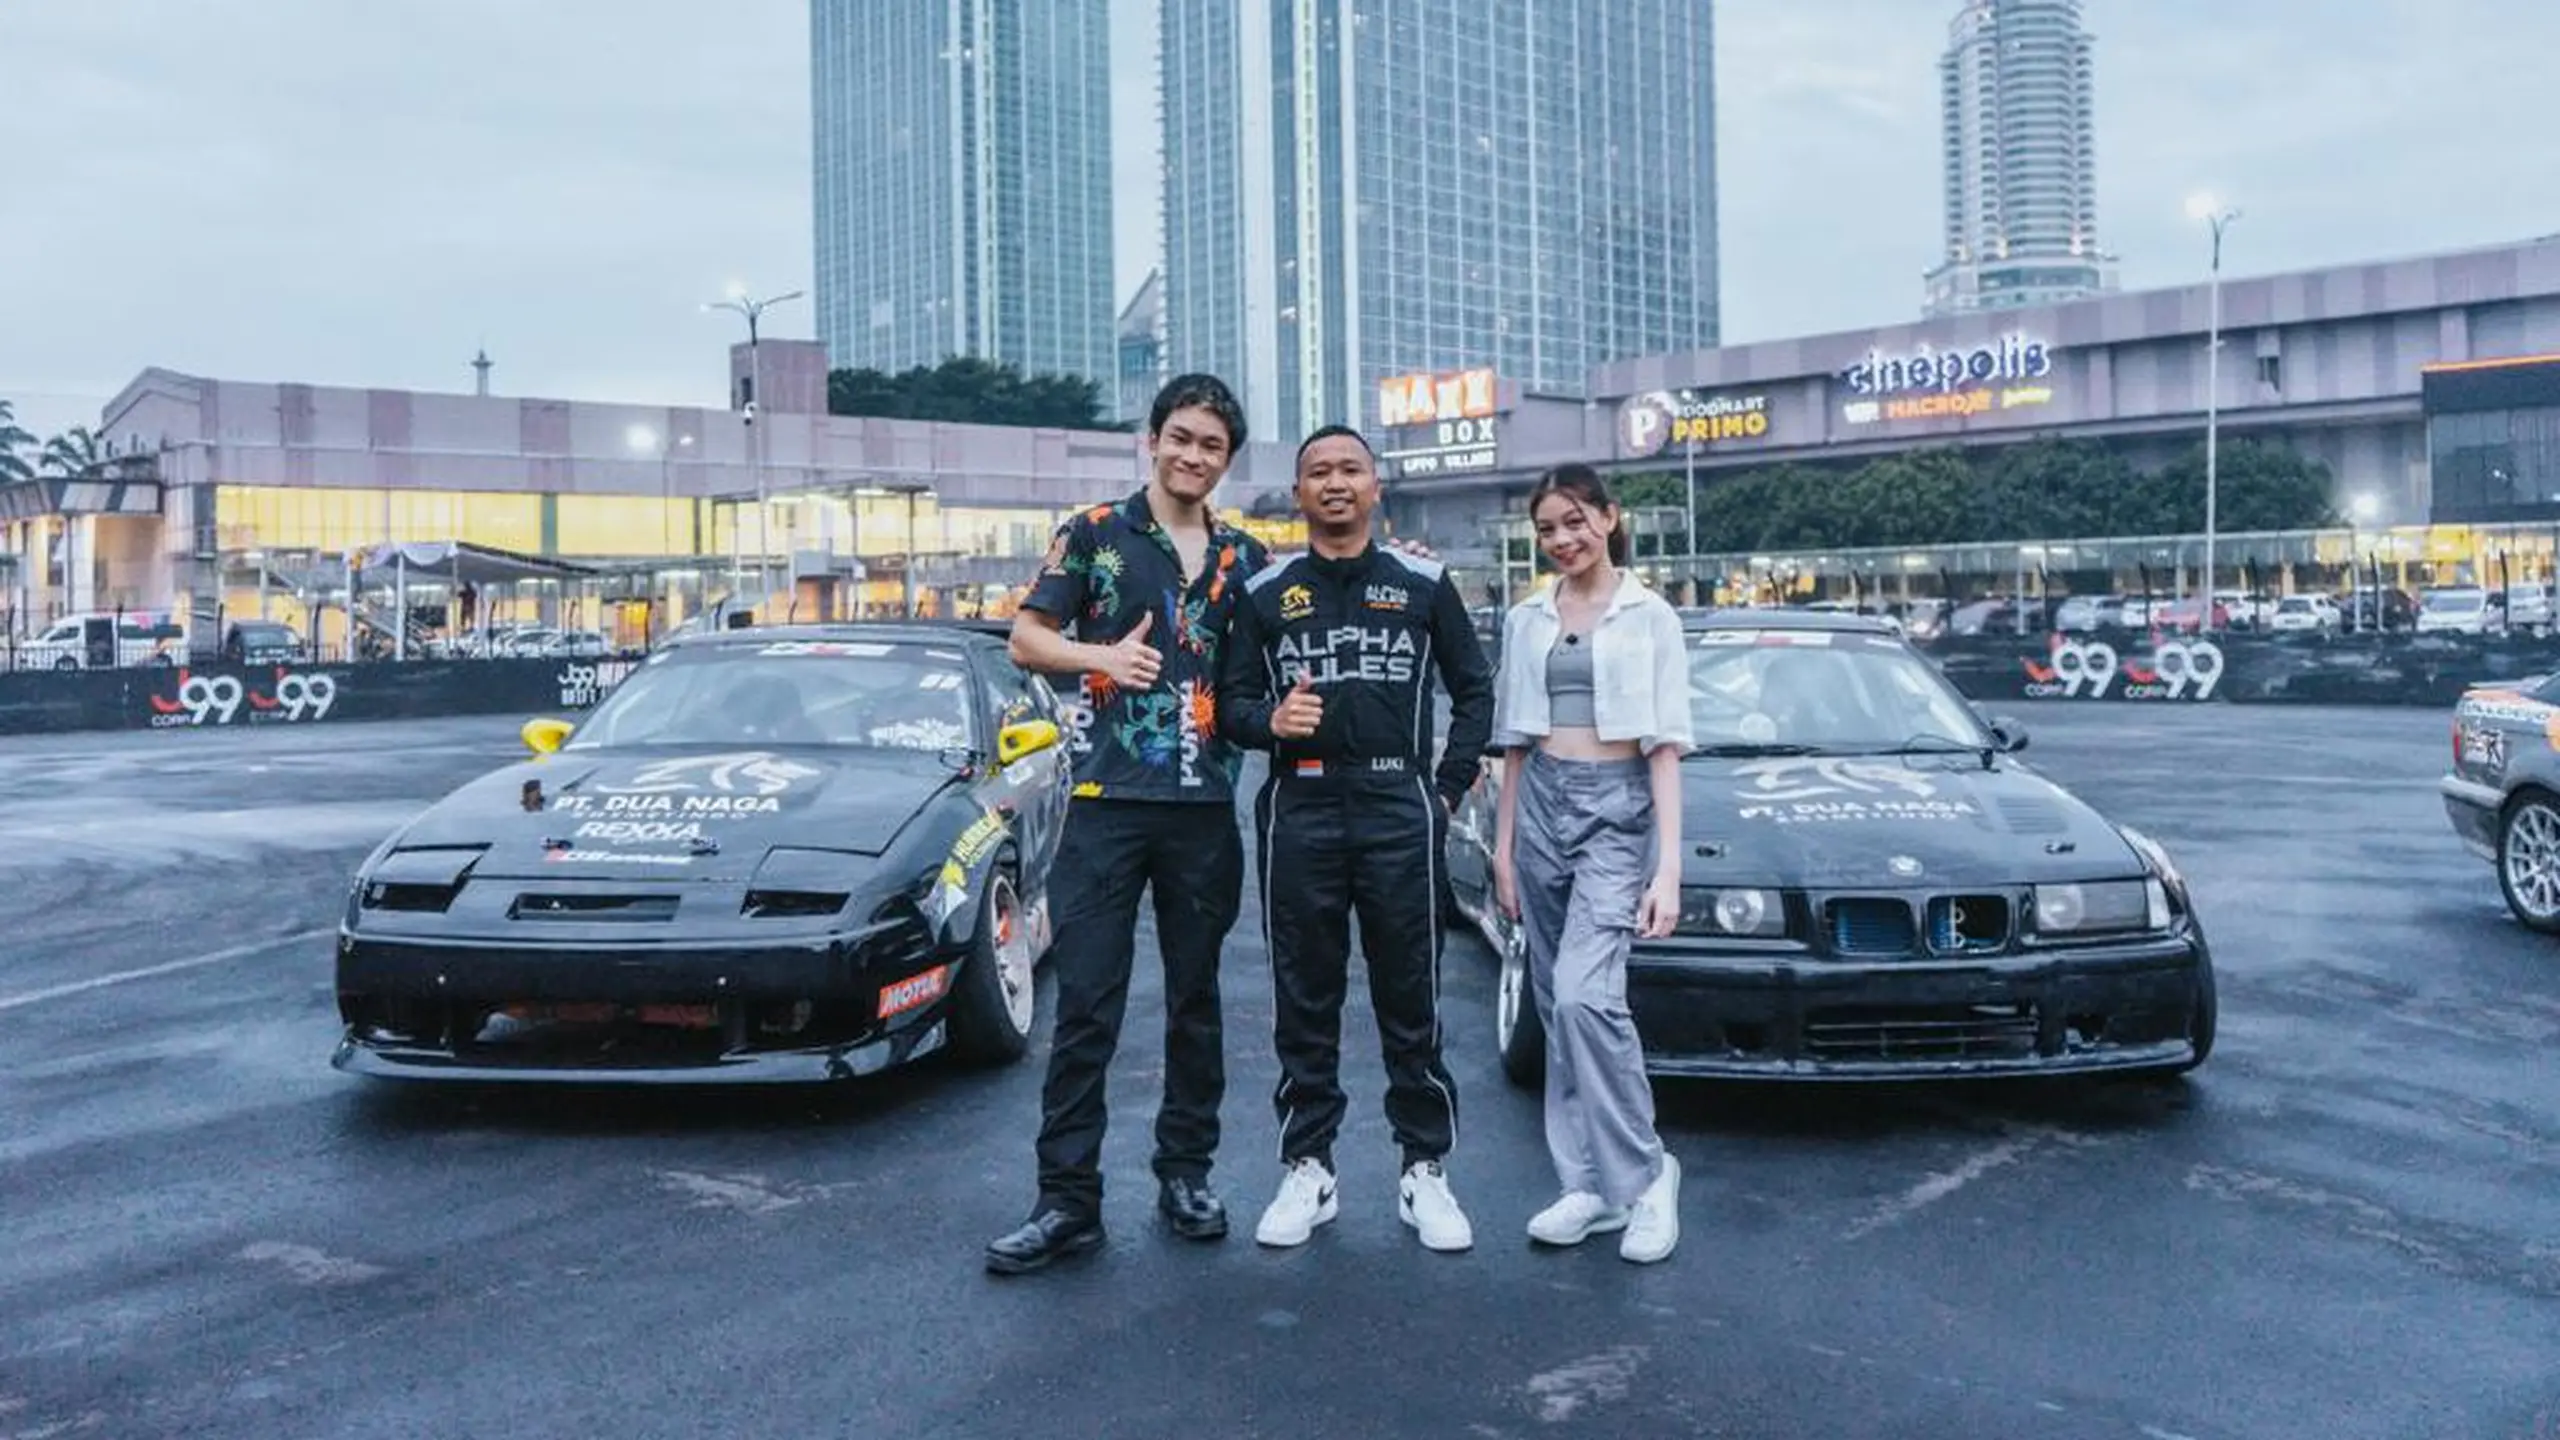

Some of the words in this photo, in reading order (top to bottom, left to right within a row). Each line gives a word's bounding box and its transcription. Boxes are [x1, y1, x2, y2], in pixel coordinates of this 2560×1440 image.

[1438, 418, 1494, 444] BOX
[1672, 412, 1767, 442] PRIMO
[1276, 626, 1416, 660] ALPHA
[1279, 655, 1416, 686] RULES
[1371, 756, 1405, 771] LUKI
[604, 796, 672, 811] DUA
[682, 796, 780, 812] NAGA
[1792, 801, 1868, 814] DUA
